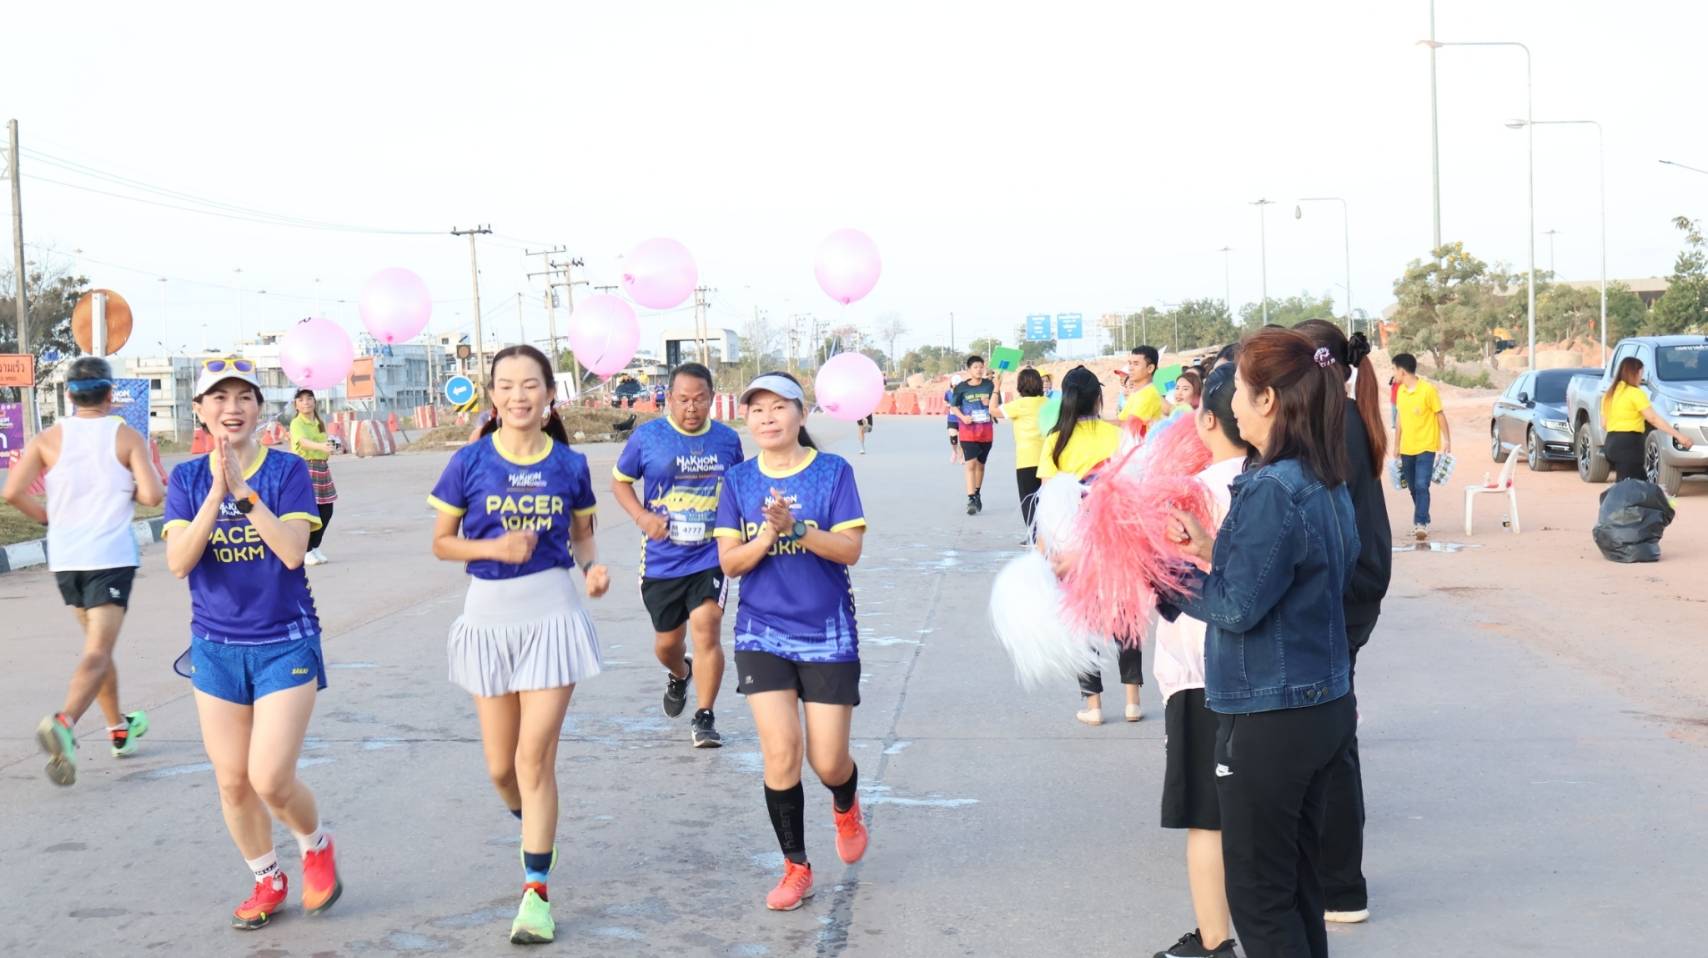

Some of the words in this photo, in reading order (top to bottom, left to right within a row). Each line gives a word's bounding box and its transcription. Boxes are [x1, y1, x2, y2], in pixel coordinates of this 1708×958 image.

[486, 495, 564, 515] PACER
[502, 516, 552, 531] 10KM
[213, 545, 265, 563] 10KM
